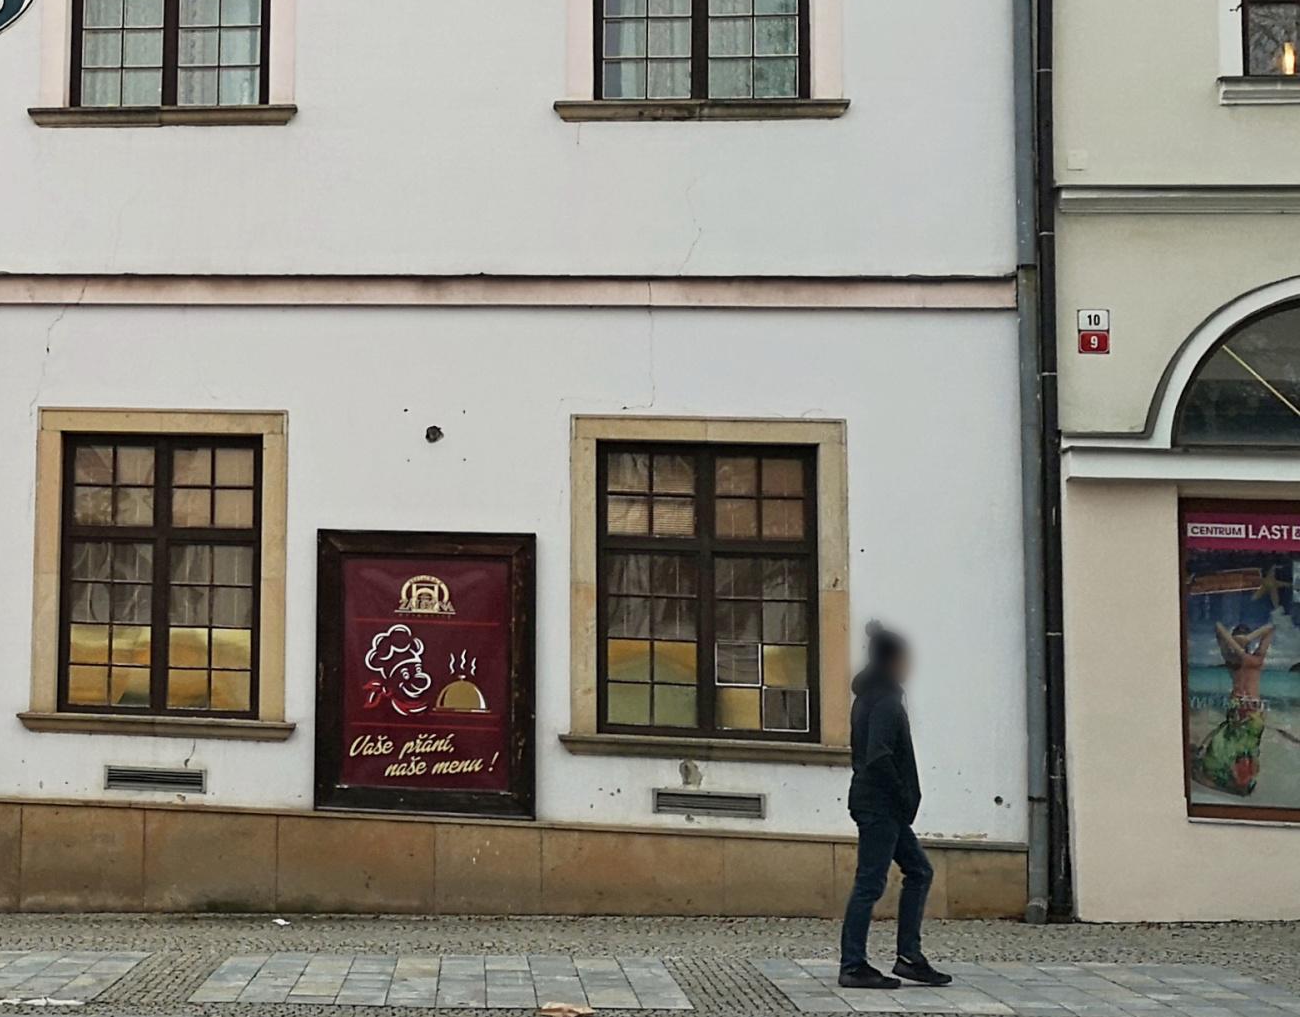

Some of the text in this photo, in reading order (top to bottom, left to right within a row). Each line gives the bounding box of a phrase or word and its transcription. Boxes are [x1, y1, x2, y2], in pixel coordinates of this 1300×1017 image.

[1087, 314, 1100, 326] 10
[1090, 335, 1098, 349] 9
[1190, 526, 1243, 536] CENTRUM
[1248, 525, 1290, 540] LAST
[350, 734, 455, 760] Vaše přání,
[384, 756, 428, 777] naše
[431, 758, 484, 775] menu
